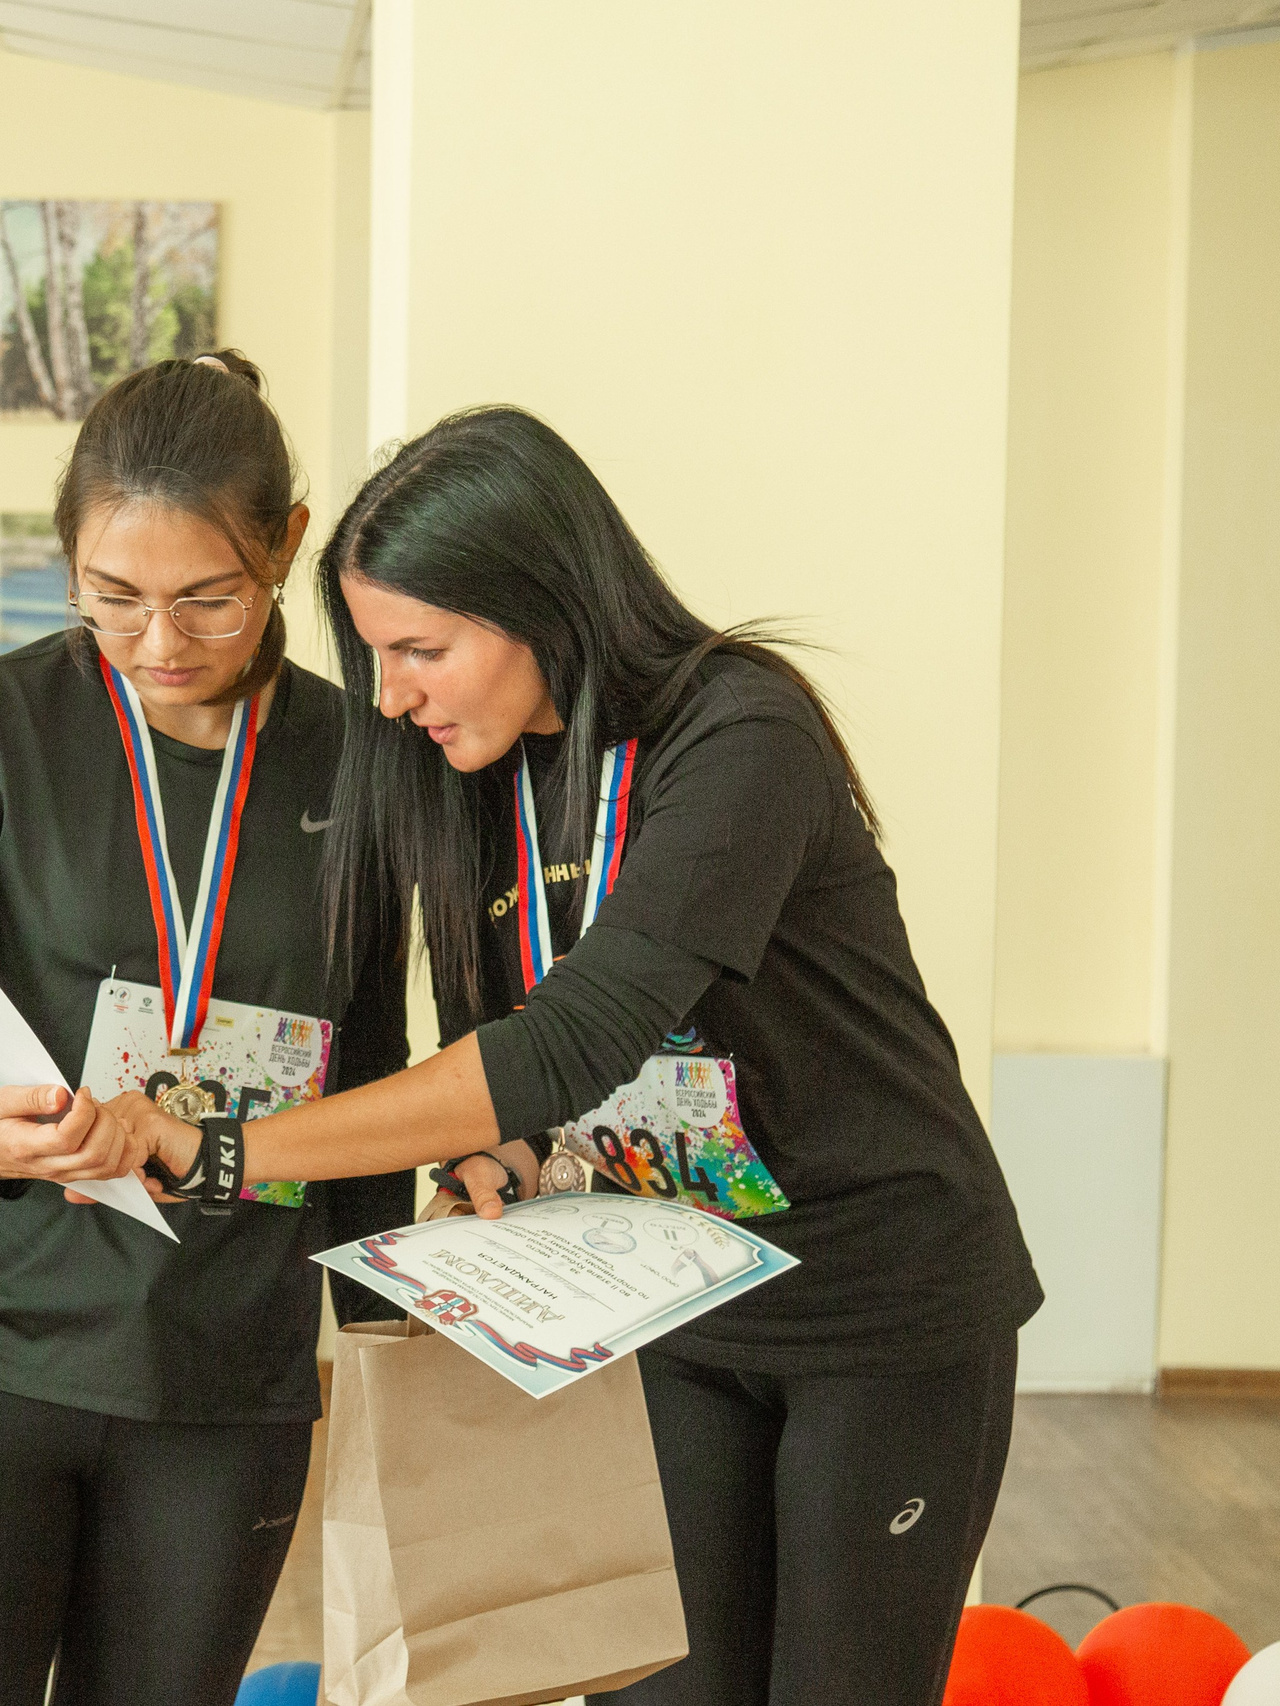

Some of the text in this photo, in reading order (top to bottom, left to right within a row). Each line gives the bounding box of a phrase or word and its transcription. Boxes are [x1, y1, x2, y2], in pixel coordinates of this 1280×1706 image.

[270, 1044, 312, 1058] ВСЕРОССИЙСКИЙ
[268, 1054, 312, 1068] ДЕНЬ ХОДЬБЫ
[281, 1065, 296, 1077] 2024
[675, 1088, 716, 1098] ВСЕРОССИЙСКИЙ
[179, 1094, 194, 1117] 1
[676, 1098, 718, 1109] ДЕНЬ ХОДЬБЫ
[691, 1108, 706, 1118] 2024
[213, 1134, 236, 1202] LEKI
[592, 1125, 719, 1202] 834
[491, 1223, 527, 1238] области
[524, 1243, 552, 1258] место
[526, 1237, 560, 1255] Омской
[548, 1239, 583, 1258] туризму
[559, 1254, 587, 1269] Кубка
[571, 1244, 614, 1271] "Северная
[475, 1252, 558, 1299] НАГРАЖДАЕТСЯ
[582, 1257, 638, 1292] спортивному
[584, 1268, 612, 1284] этапе
[427, 1248, 566, 1323] ДИПЛОМ
[617, 1288, 631, 1296] во
[636, 1291, 650, 1299] по
